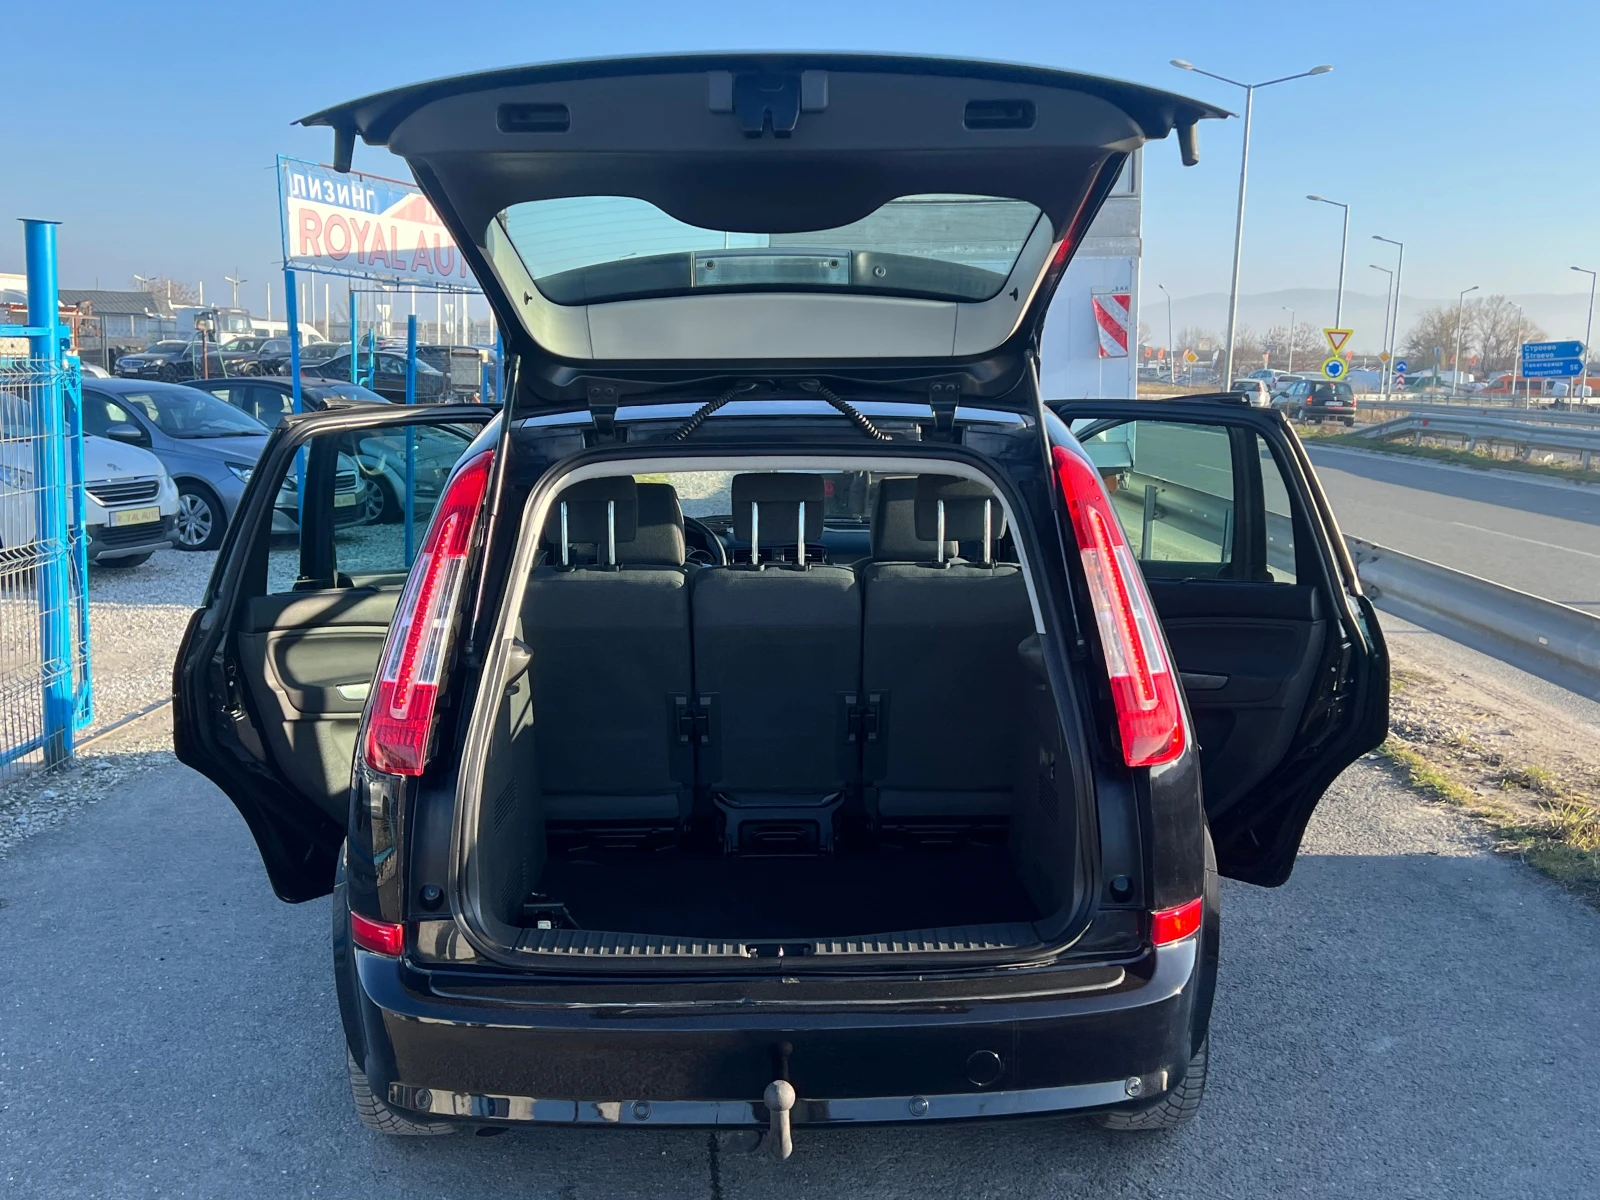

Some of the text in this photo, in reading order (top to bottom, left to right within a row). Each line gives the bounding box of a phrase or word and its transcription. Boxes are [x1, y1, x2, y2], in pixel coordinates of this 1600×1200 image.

[293, 174, 374, 210] ЛИЗИНГ
[299, 208, 407, 271] ROYAL
[117, 513, 140, 523] RYAL
